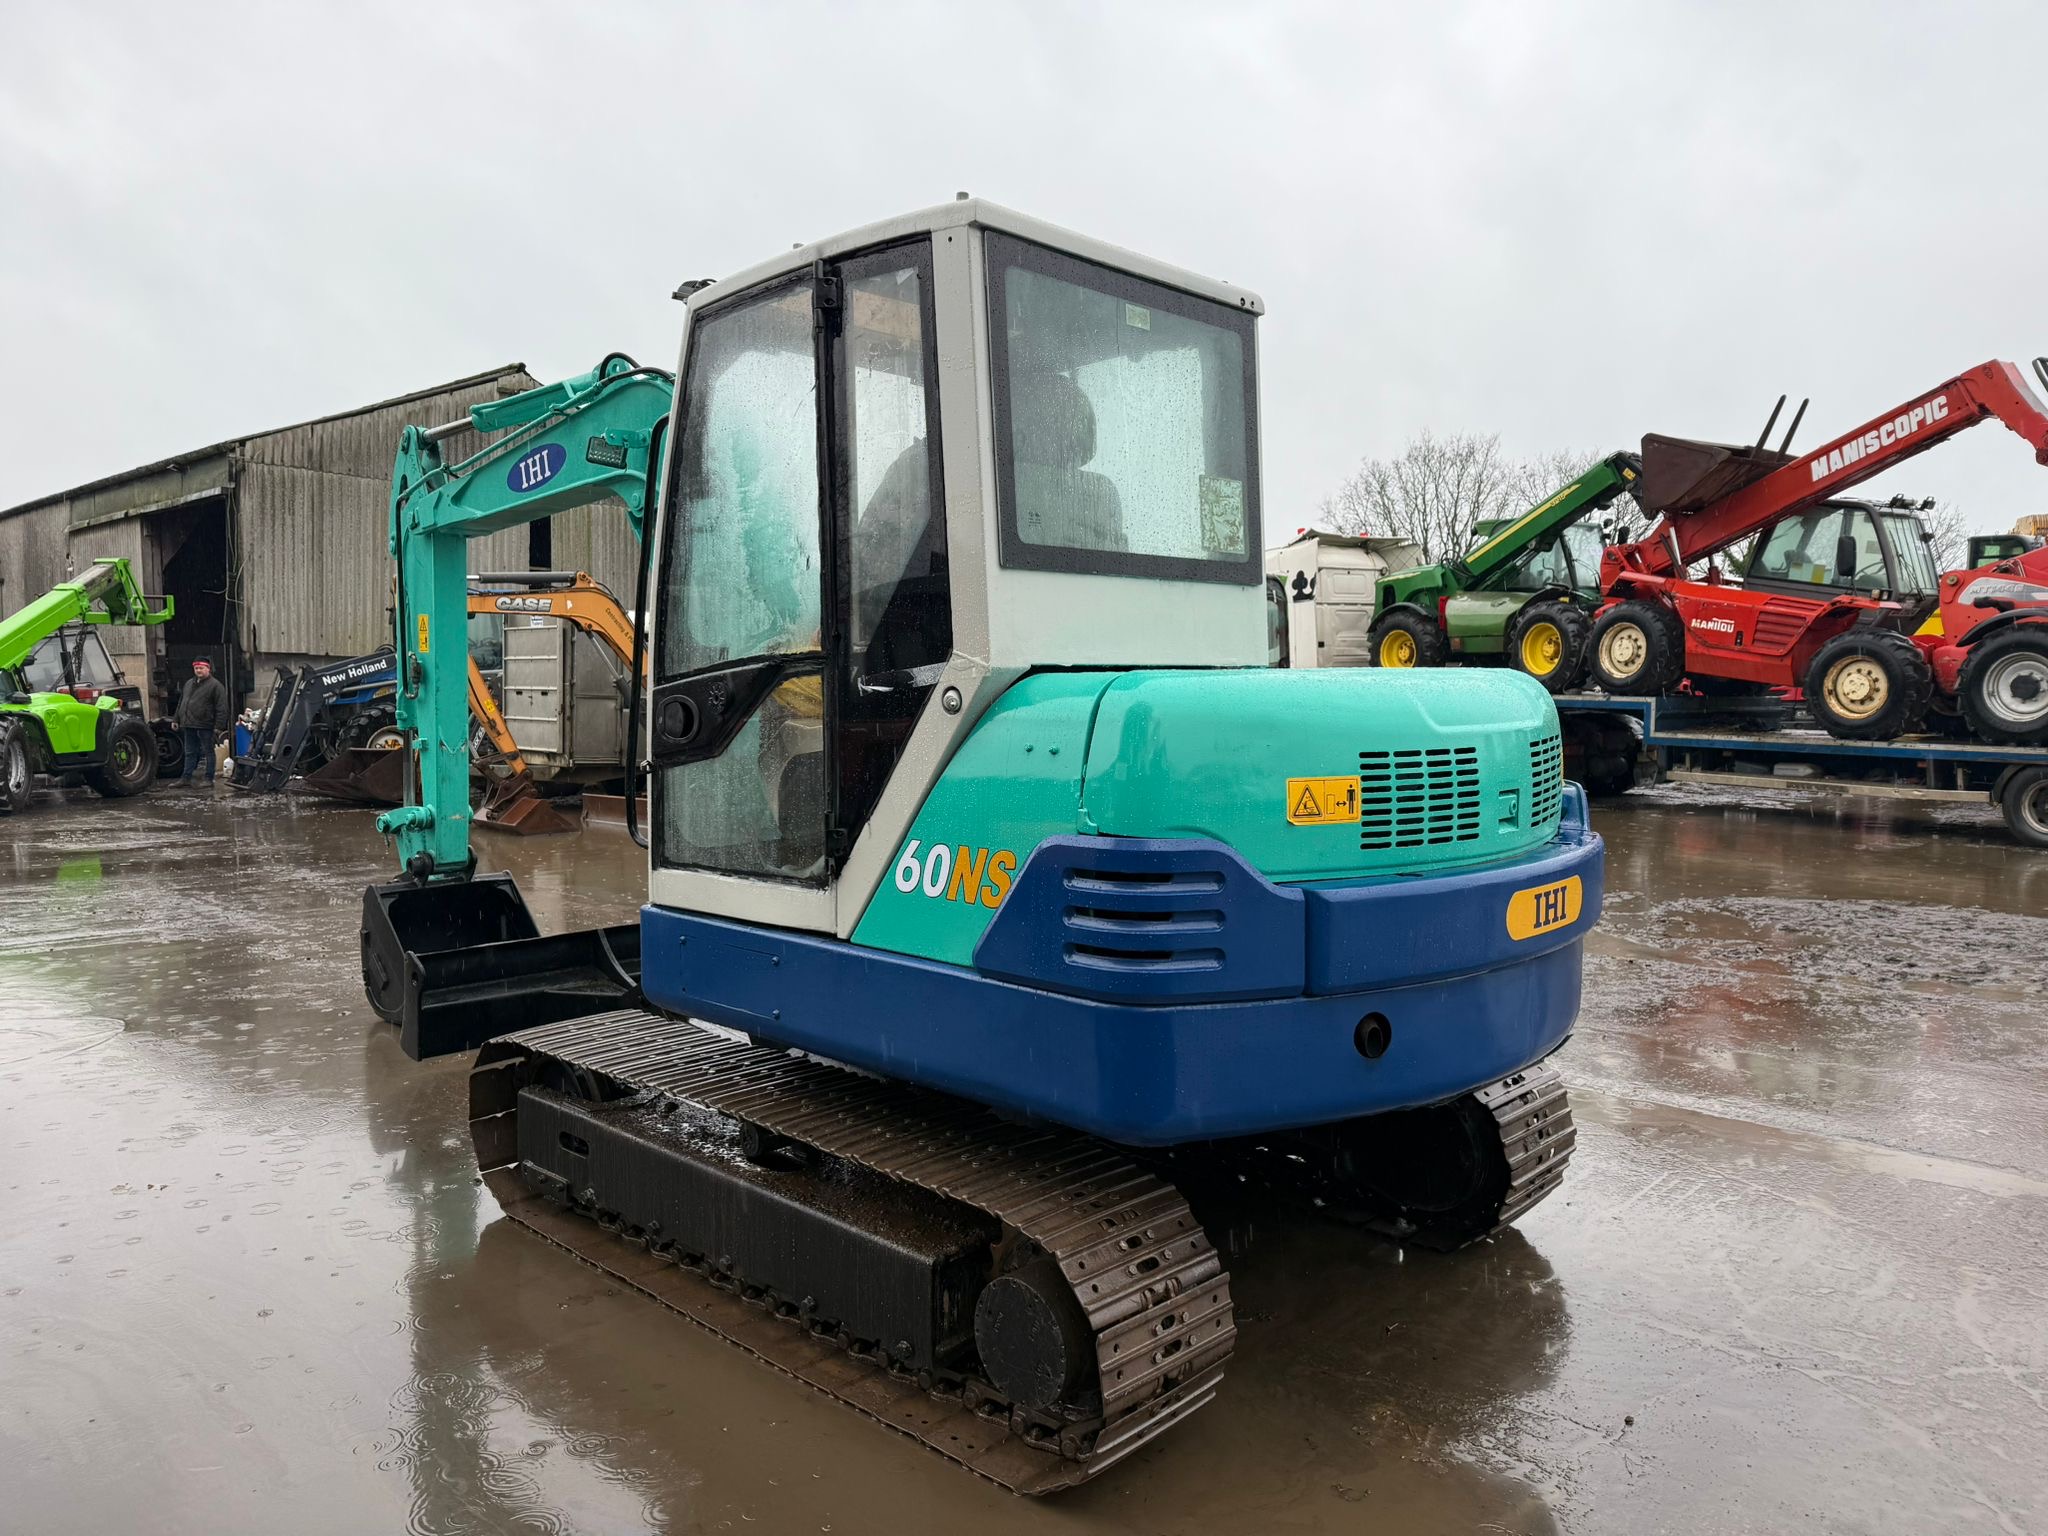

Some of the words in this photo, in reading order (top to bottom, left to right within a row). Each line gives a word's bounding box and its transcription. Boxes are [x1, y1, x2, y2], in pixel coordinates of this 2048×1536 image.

[1810, 395, 1949, 482] MANISCOPIC
[519, 449, 551, 489] IHI
[495, 596, 552, 612] CASE
[1691, 617, 1735, 633] MANITOU
[322, 672, 346, 686] New
[347, 659, 387, 678] Holland
[895, 839, 1017, 909] 60NS
[1533, 885, 1567, 929] IHI
